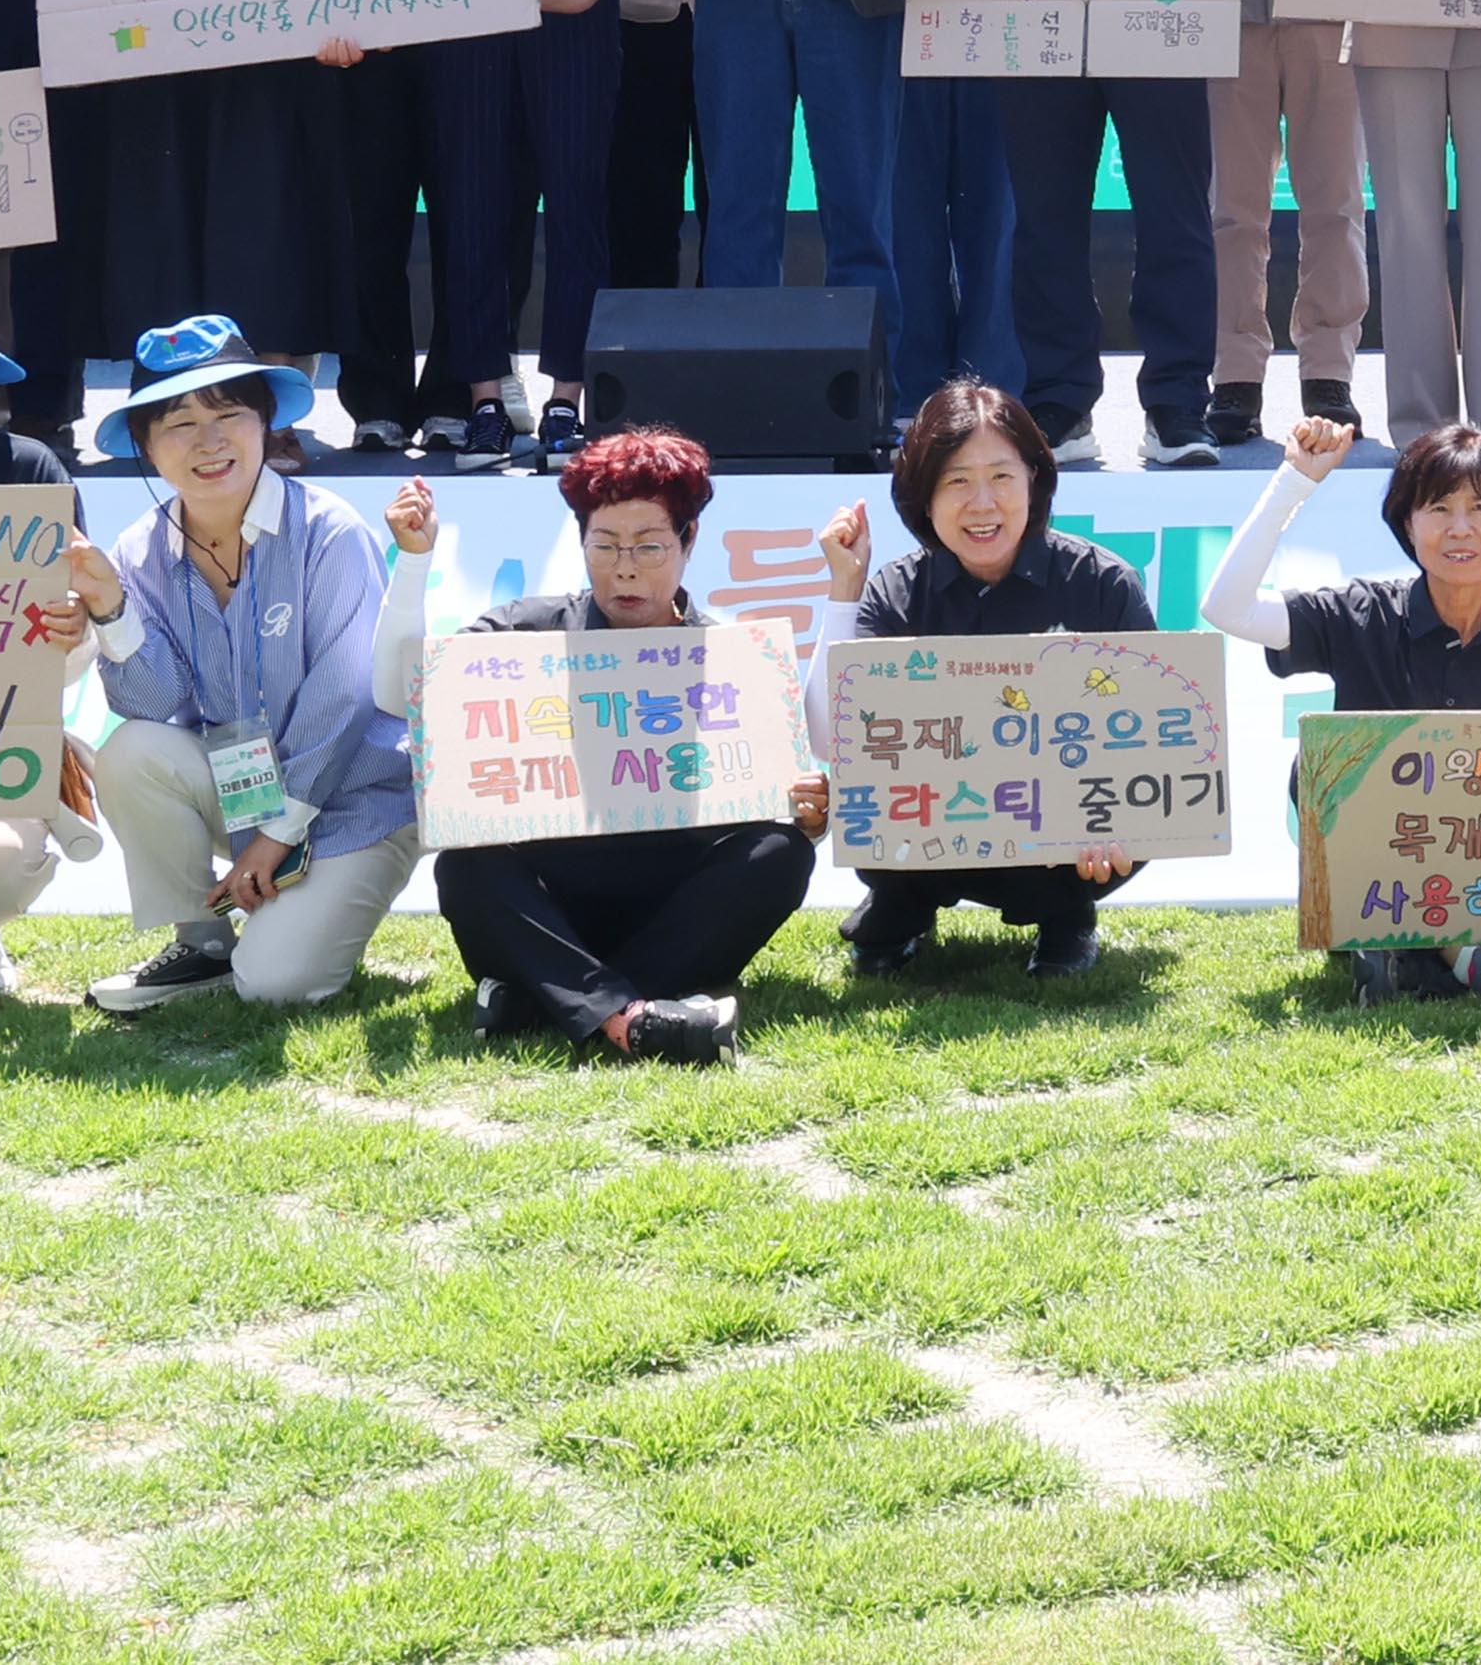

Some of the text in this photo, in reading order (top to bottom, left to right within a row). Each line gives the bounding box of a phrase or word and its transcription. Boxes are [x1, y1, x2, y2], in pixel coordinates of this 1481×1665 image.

[1124, 9, 1204, 47] 재활용
[464, 658, 524, 679] 서운산
[862, 708, 1197, 770] 목재 이용으로
[468, 741, 752, 805] 목재 사용!!
[835, 770, 1225, 847] 플라스틱 줄이기
